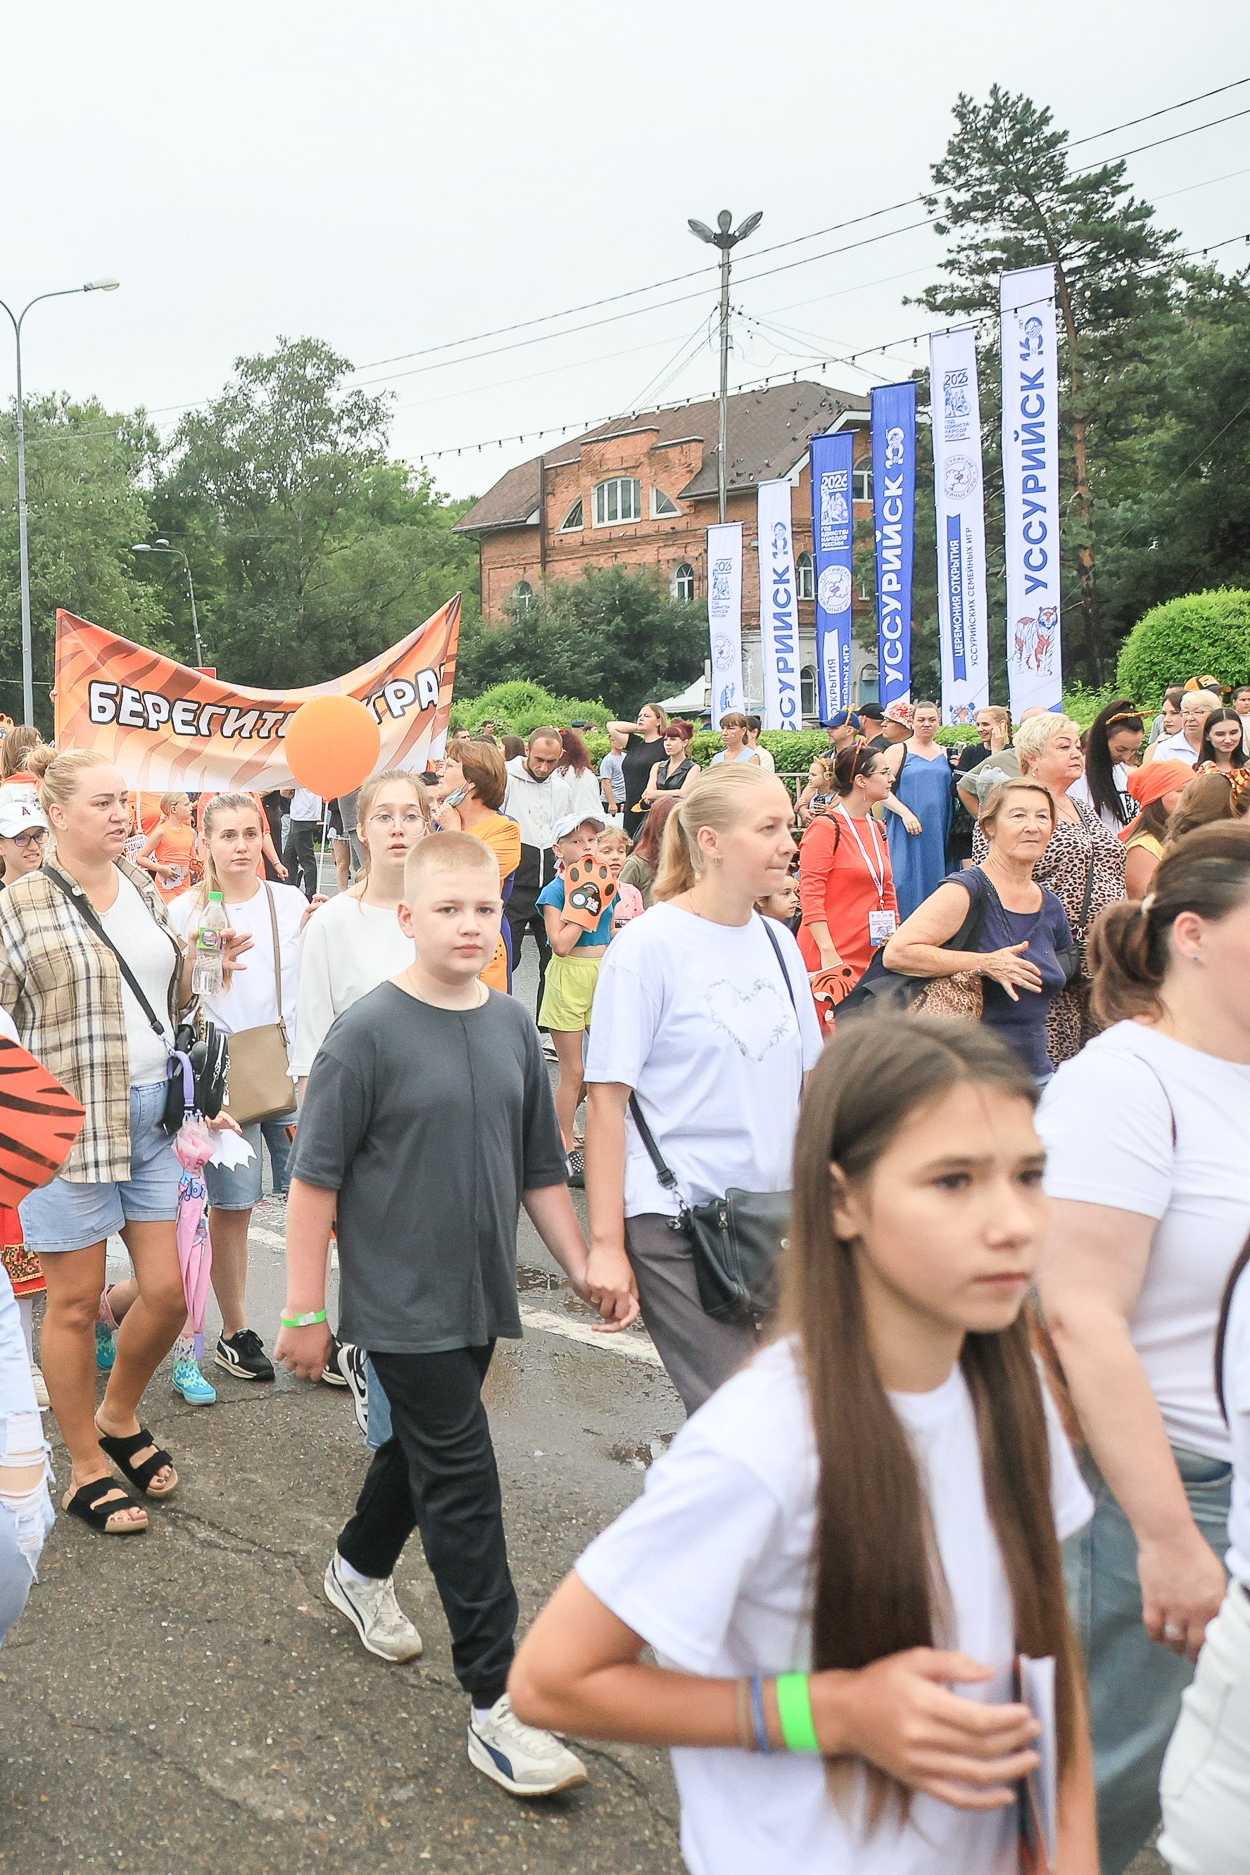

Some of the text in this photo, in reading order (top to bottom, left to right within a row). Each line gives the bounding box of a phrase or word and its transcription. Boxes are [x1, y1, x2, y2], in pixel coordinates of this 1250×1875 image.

[821, 473, 848, 489] 2026
[1013, 366, 1049, 596] УССУРИЙСК
[875, 472, 905, 687] УССУРИЙСК
[949, 539, 965, 658] ЦЕРЕМОНИЯ ОТКРЫТИЯ
[965, 527, 980, 668] УССУРИЙСКИХ СЕМЕЙНЫХ ИГР
[842, 644, 851, 664] ИГР
[21, 806, 31, 816] A
